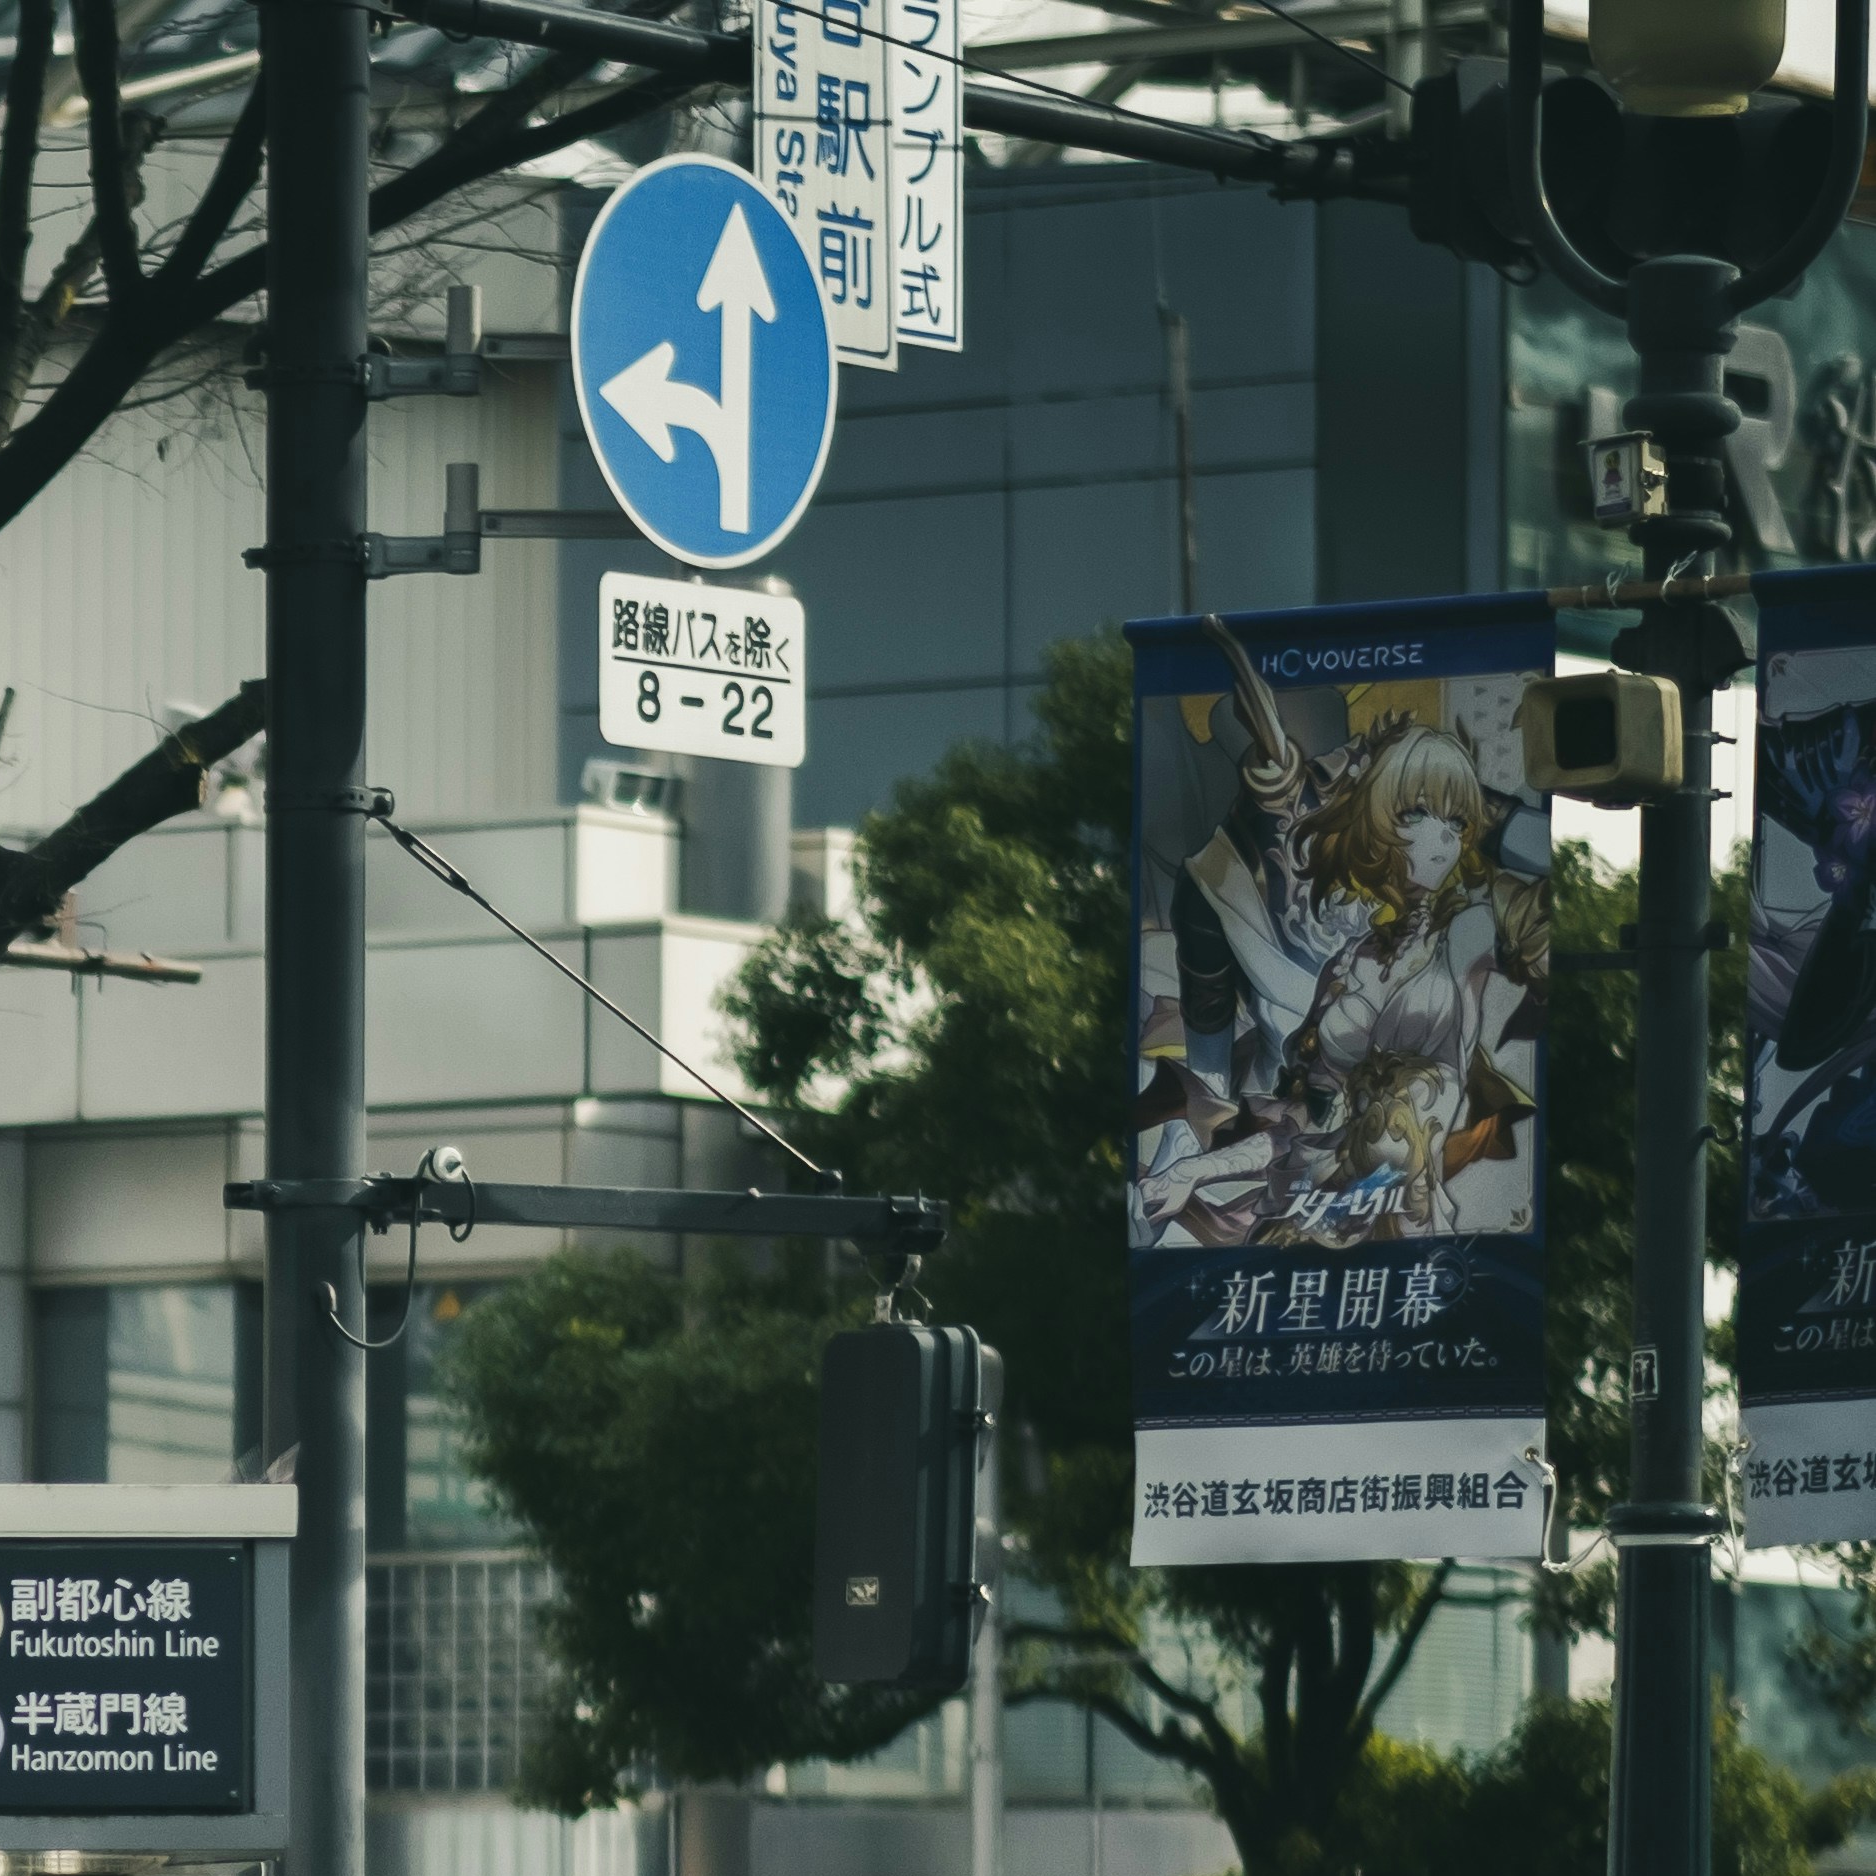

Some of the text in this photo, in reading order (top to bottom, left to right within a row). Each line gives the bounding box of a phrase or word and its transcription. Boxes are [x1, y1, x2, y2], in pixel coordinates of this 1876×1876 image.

[613, 598, 790, 673] 路線バスを除く
[1262, 642, 1424, 678] HOYOVERSE
[1211, 1262, 1447, 1336] 新星開幕
[1167, 1336, 1499, 1380] この星は、英雄を待っていた。
[1144, 1470, 1529, 1519] 渋谷道玄坂商店街振興組合
[11, 1577, 192, 1622] 副都心線
[10, 1628, 219, 1658] Fukutoshin Line
[11, 1691, 188, 1736] 半蔵門線
[11, 1743, 218, 1772] Hanzomon Line
